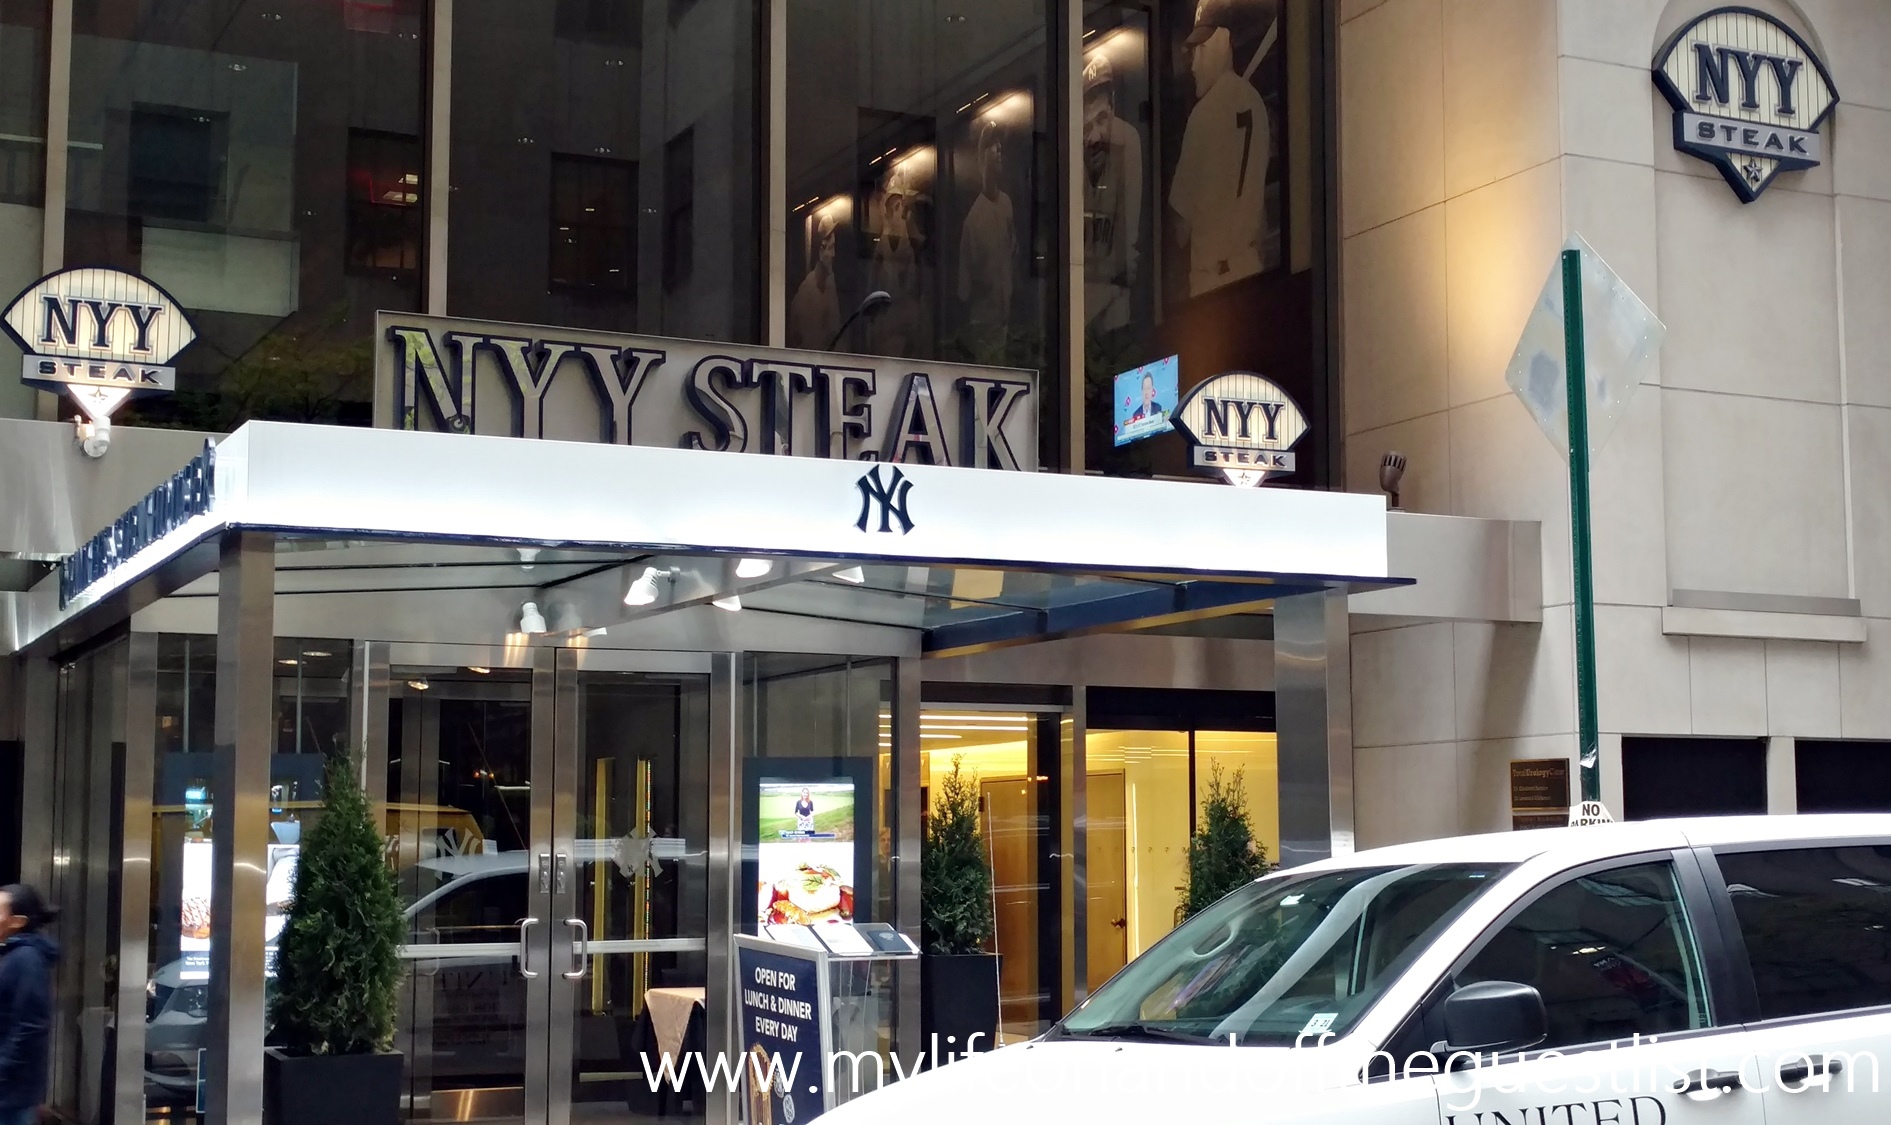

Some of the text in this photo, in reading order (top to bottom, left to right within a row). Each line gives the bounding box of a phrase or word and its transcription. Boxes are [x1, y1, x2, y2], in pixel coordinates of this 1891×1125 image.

[1692, 40, 1804, 117] NYY
[1235, 108, 1253, 198] 7
[1697, 121, 1809, 155] STEAK
[39, 295, 165, 355] NYY
[38, 360, 163, 386] STEAK
[386, 326, 1030, 471] NYY STEAK
[1202, 396, 1285, 442] NYY
[1203, 450, 1287, 468] STEAK
[1582, 803, 1600, 816] NO
[755, 966, 796, 991] OPEN FOR
[744, 988, 812, 1020] LUNCH & DINNER
[755, 1016, 798, 1043] EVERY DAY
[1445, 1095, 1667, 1125] ITED
